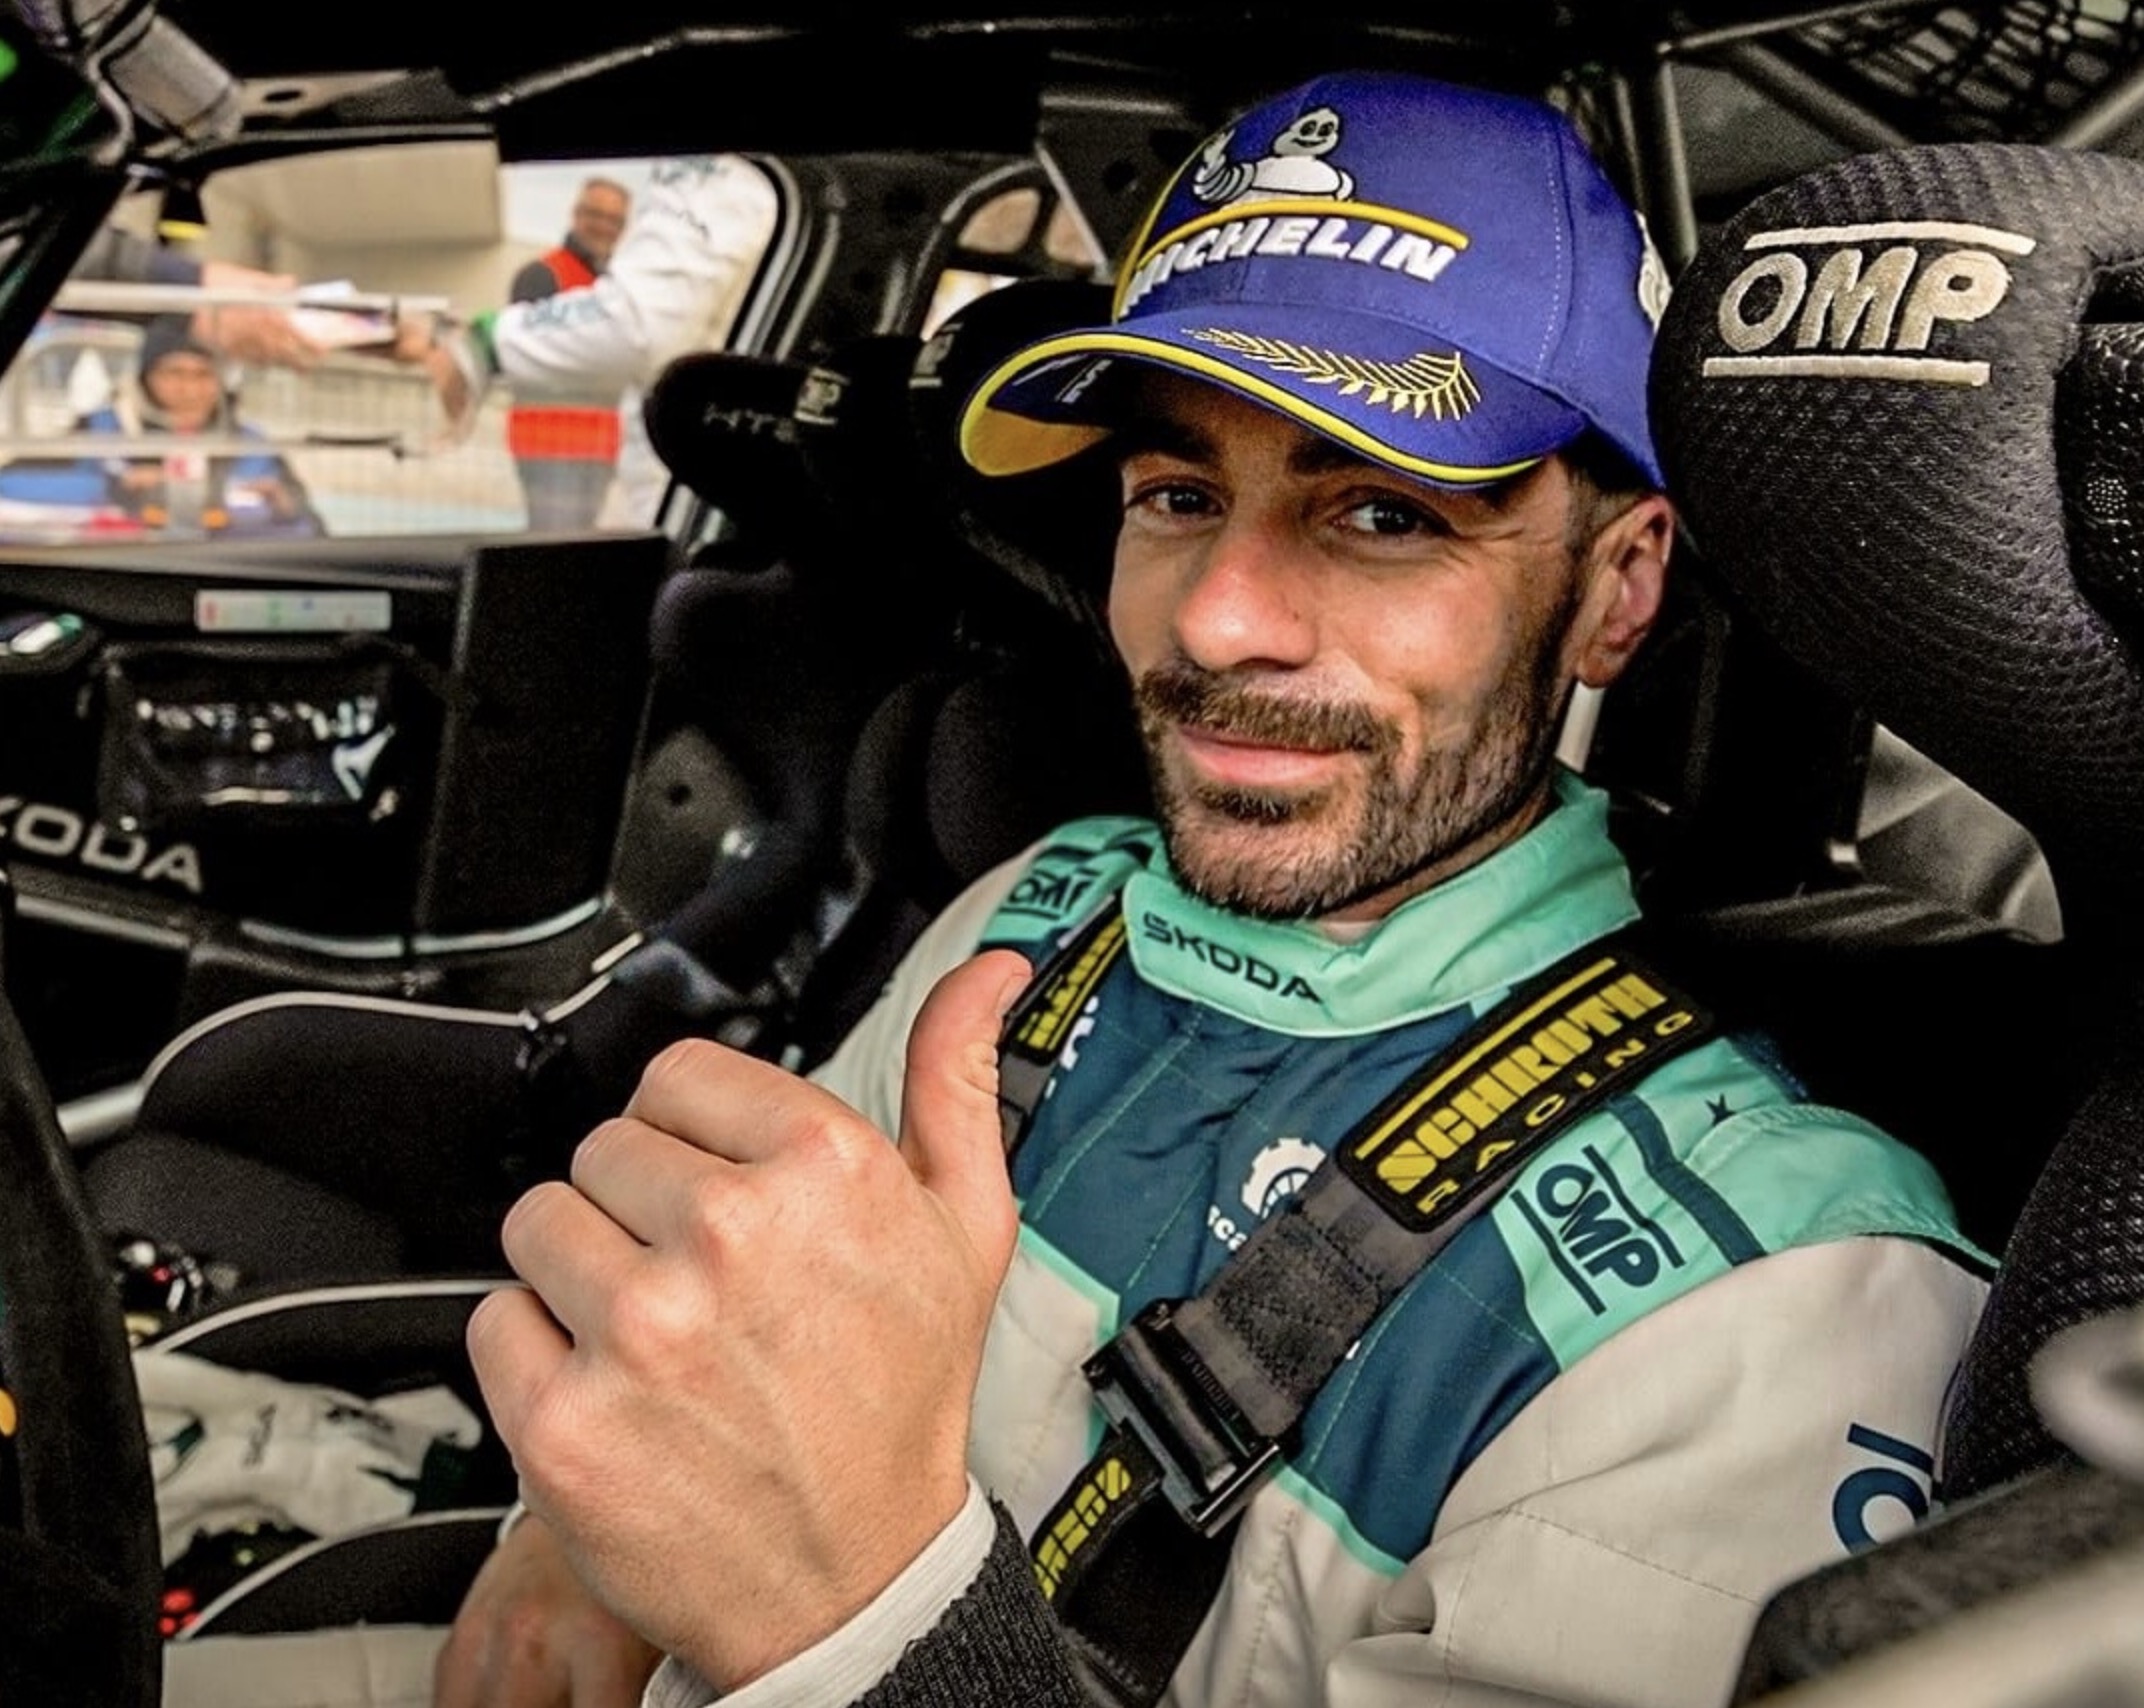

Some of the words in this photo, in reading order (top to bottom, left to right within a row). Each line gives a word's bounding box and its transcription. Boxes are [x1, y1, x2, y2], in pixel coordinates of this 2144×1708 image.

[1117, 217, 1456, 318] MICHELIN
[1718, 246, 2013, 353] OMP
[1376, 973, 1667, 1194] SCHROTH
[1416, 1011, 1693, 1214] RACING
[1536, 1163, 1660, 1288] OMP
